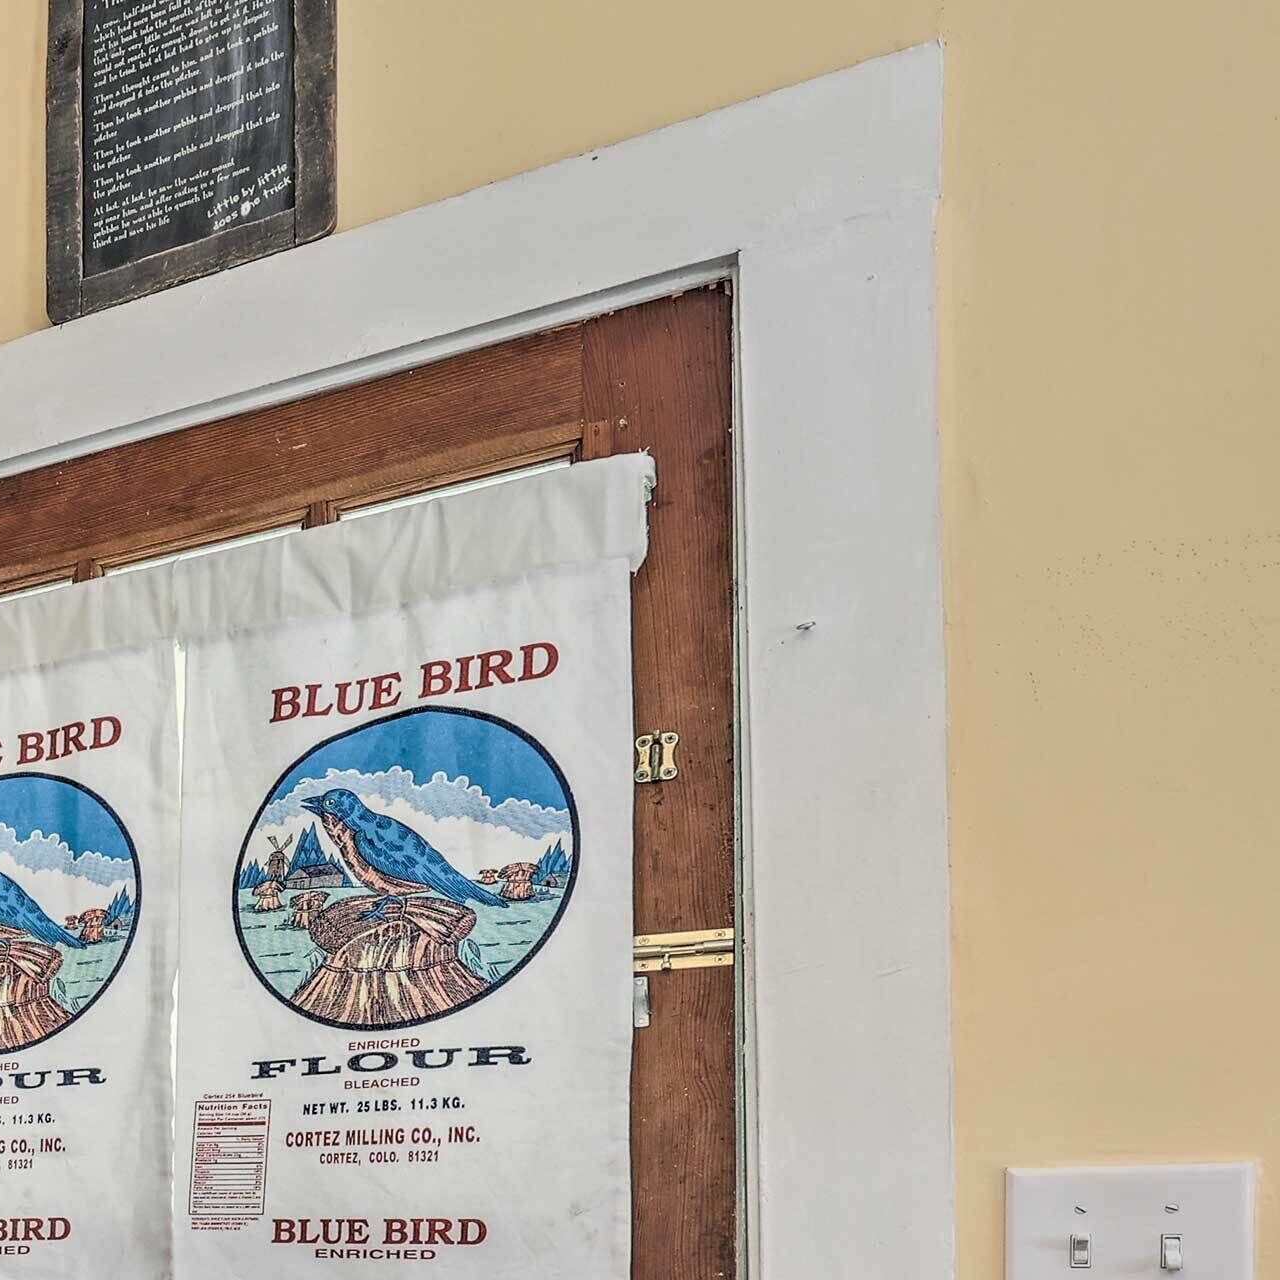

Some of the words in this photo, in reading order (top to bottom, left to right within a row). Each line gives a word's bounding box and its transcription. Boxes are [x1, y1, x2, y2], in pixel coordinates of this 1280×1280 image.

[93, 94, 114, 104] Then
[122, 75, 150, 94] thought
[152, 70, 170, 82] came
[171, 65, 179, 73] to
[200, 49, 213, 62] and
[216, 46, 225, 55] he
[227, 37, 243, 50] took
[253, 22, 279, 42] pebble
[93, 121, 114, 132] Then
[116, 116, 125, 125] he
[126, 107, 142, 120] took
[144, 99, 171, 113] another
[173, 85, 197, 103] pebble
[199, 78, 213, 91] and
[215, 65, 244, 84] dropped
[247, 62, 252, 72] it
[255, 57, 269, 68] into
[271, 51, 284, 61] the
[93, 149, 114, 160] Then
[116, 144, 125, 153] he
[126, 135, 142, 149] took
[144, 127, 171, 142] another
[173, 114, 197, 132] pebble
[199, 107, 213, 120] and
[215, 95, 244, 114] dropped
[246, 87, 263, 101] that
[265, 82, 280, 94] into
[93, 206, 104, 217] At
[122, 196, 130, 206] at
[148, 188, 157, 197] he
[159, 184, 173, 193] saw
[174, 177, 187, 187] the
[189, 169, 209, 181] water
[212, 157, 235, 173] mount
[93, 219, 103, 228] up
[105, 214, 120, 223] near
[140, 198, 153, 211] and
[155, 194, 172, 205] after
[174, 186, 198, 198] casting
[200, 182, 207, 190] in
[217, 173, 230, 183] few
[232, 166, 250, 177] more
[207, 195, 240, 218] Little
[241, 184, 255, 197] by
[257, 163, 288, 188] little
[213, 210, 238, 230] does
[262, 176, 292, 199] trick
[92, 236, 112, 249] thirst
[114, 230, 127, 242] and
[129, 227, 144, 237] save
[146, 222, 157, 231] his
[158, 215, 170, 226] life
[93, 224, 119, 240] pebbles
[121, 220, 130, 229] he
[132, 215, 146, 224] was
[147, 207, 163, 219] able
[165, 204, 173, 213] to
[174, 194, 200, 211] quench
[202, 191, 214, 200] his
[269, 672, 404, 725] BLUE
[418, 643, 558, 699] BIRD
[17, 717, 121, 765] BIRD
[251, 1046, 531, 1079] FLOUR
[349, 1038, 422, 1054] ENRICHED
[345, 1077, 419, 1089] BLEACHED
[13, 1114, 33, 1124] 11.3
[38, 1113, 56, 1125] KG.
[198, 1103, 238, 1111] Nutrition
[303, 1104, 325, 1115] NET
[358, 1101, 369, 1112] 25
[375, 1099, 402, 1112] LBS.
[411, 1098, 437, 1109] 11.3
[443, 1097, 465, 1110] KG.
[40, 1138, 67, 1153] INC.
[286, 1131, 340, 1147] CORTEZ
[346, 1128, 404, 1145] MILLING
[449, 1127, 481, 1144] INC.
[8, 1159, 32, 1169] 81321
[409, 1151, 438, 1162] 81321
[272, 1219, 369, 1244] BLUE
[382, 1219, 487, 1245] BIRD
[315, 1249, 435, 1259] ENRICHED
